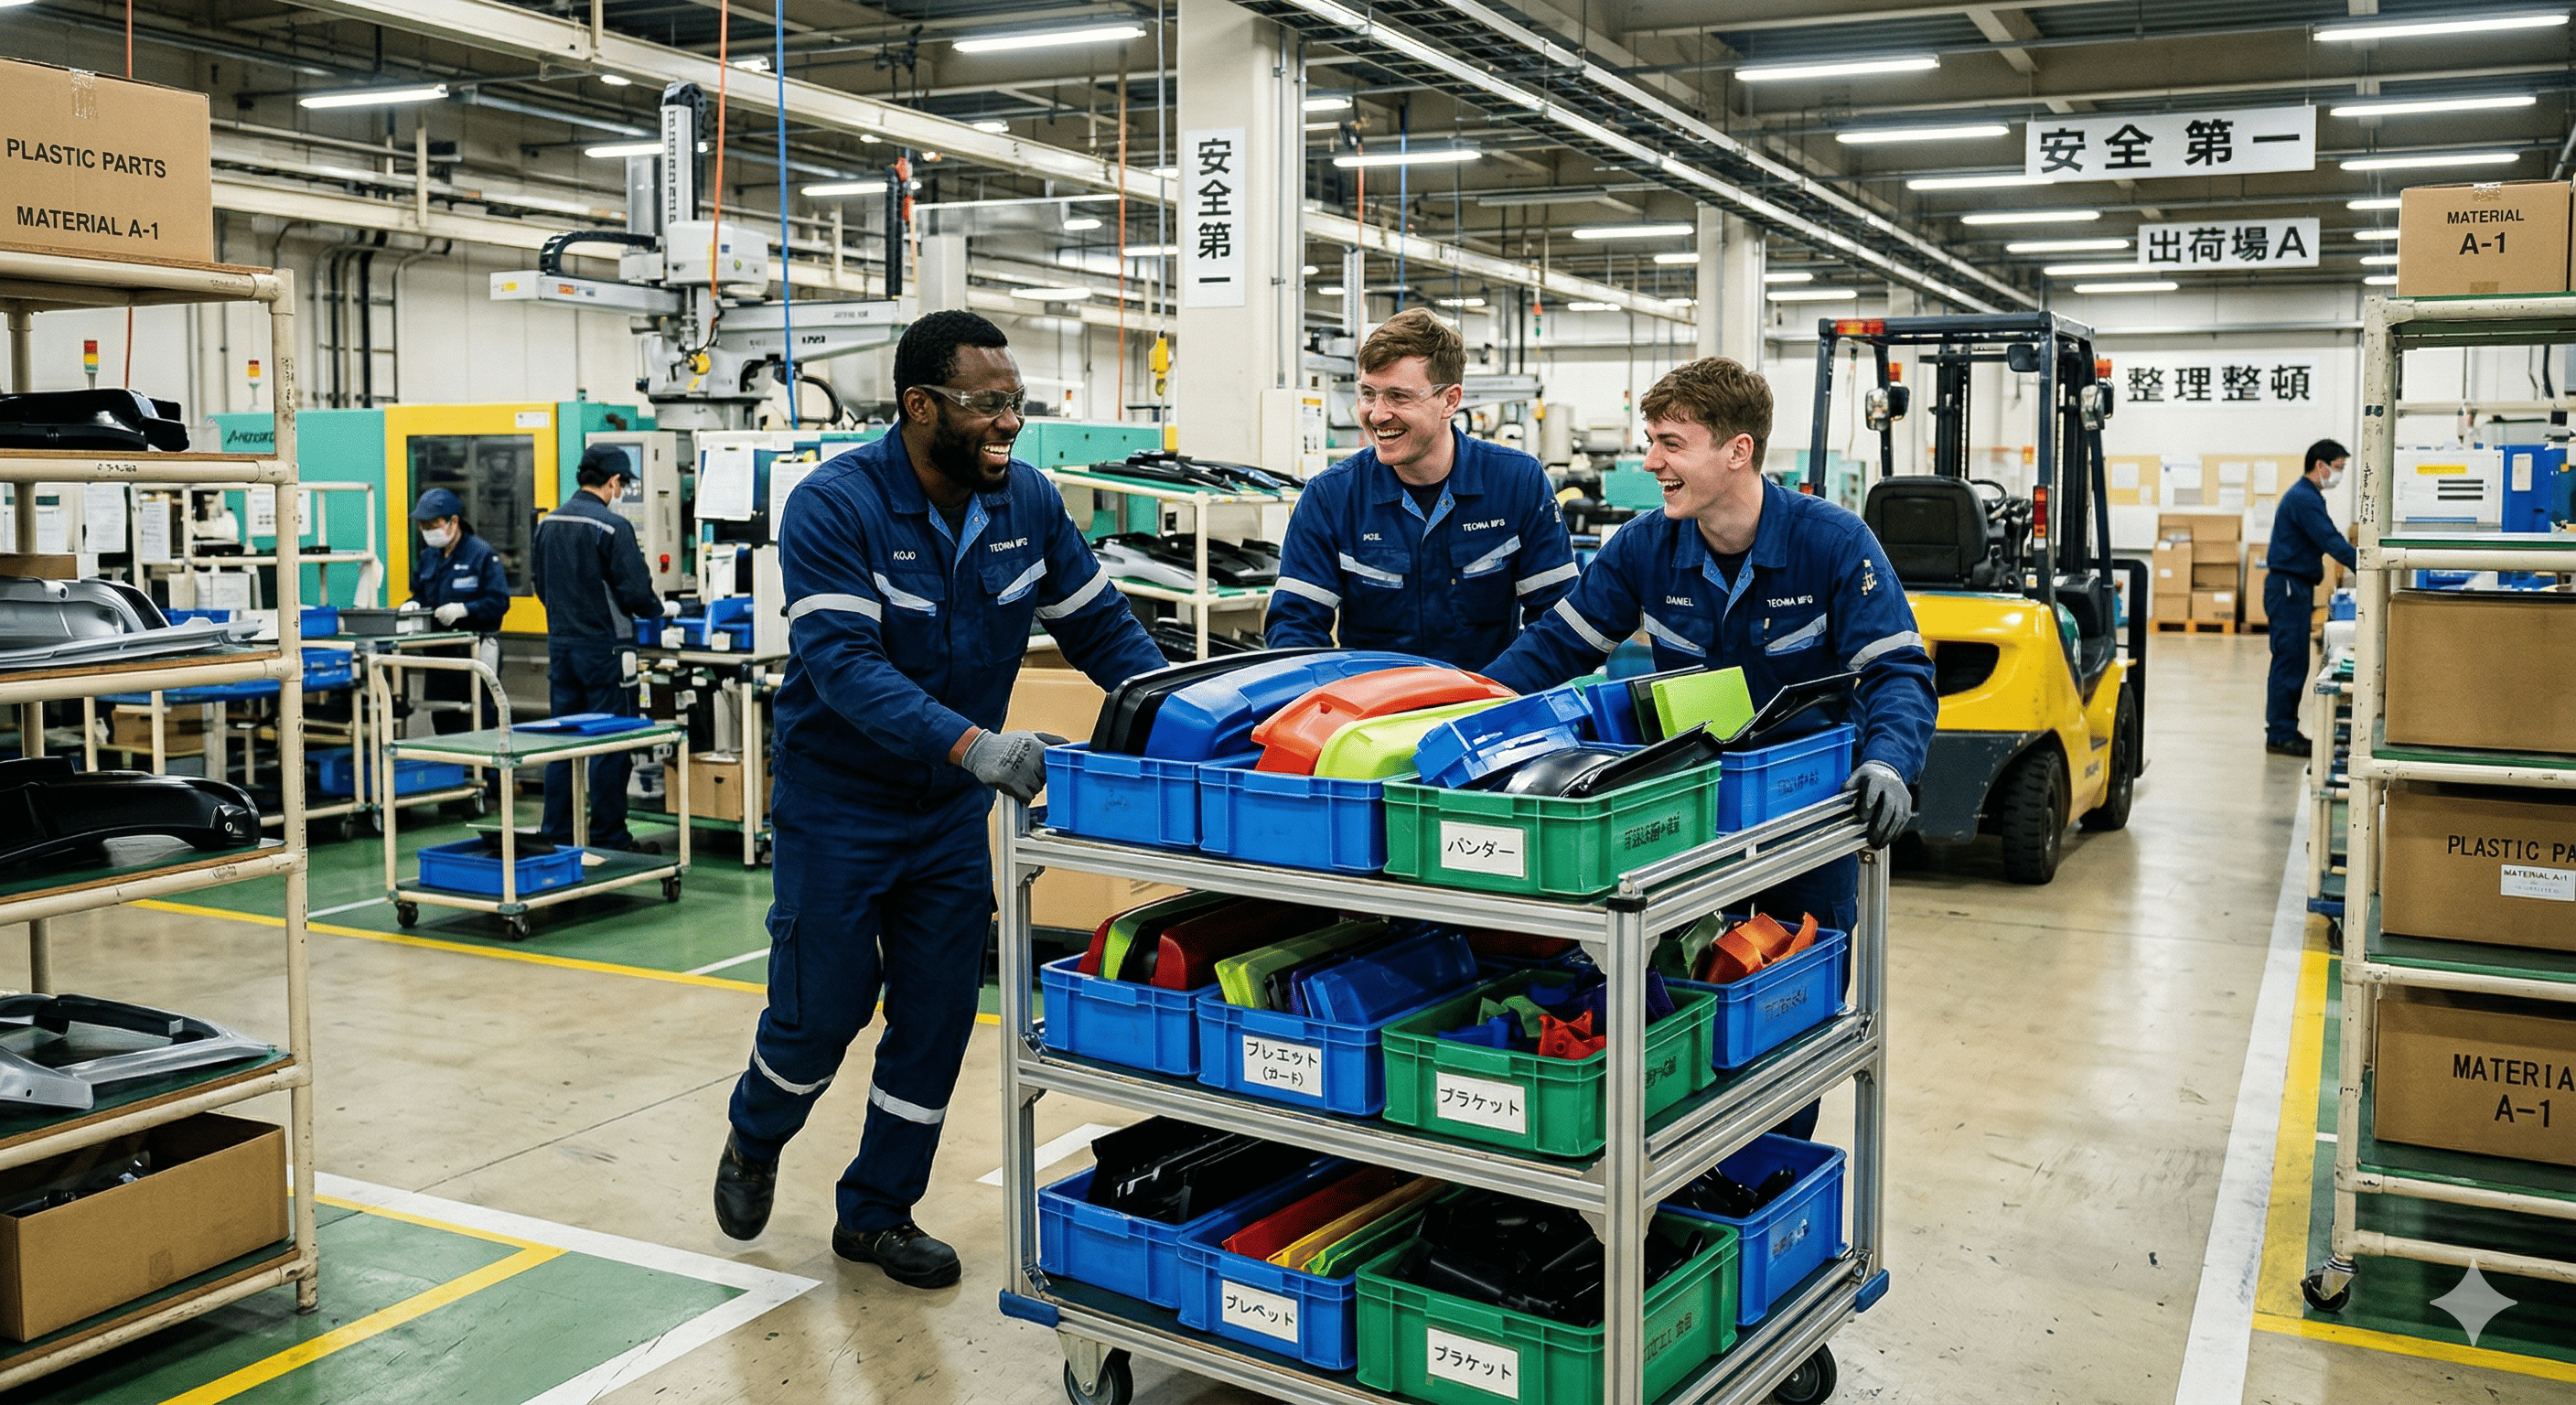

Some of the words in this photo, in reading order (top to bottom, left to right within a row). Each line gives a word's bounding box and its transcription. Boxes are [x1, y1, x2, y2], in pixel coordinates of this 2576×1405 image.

[6, 137, 96, 169] PLASTIC
[102, 151, 166, 178] PARTS
[2039, 118, 2300, 174] 安全第一
[16, 205, 123, 237] MATERIAL
[128, 219, 158, 240] A-1
[1197, 138, 1232, 283] 安全第一
[2447, 209, 2525, 224] MATERIAL
[2148, 226, 2308, 263] 出荷場A
[2459, 231, 2506, 255] A-1
[2127, 364, 2312, 402] 整理整頓
[893, 551, 916, 561] KOJO
[1666, 595, 1694, 606] DANIEL
[2448, 834, 2539, 861] PLASTIC
[2453, 1053, 2575, 1092] MATERIA
[1440, 1088, 1519, 1116] ブラケット
[2494, 1093, 2550, 1128] A-1
